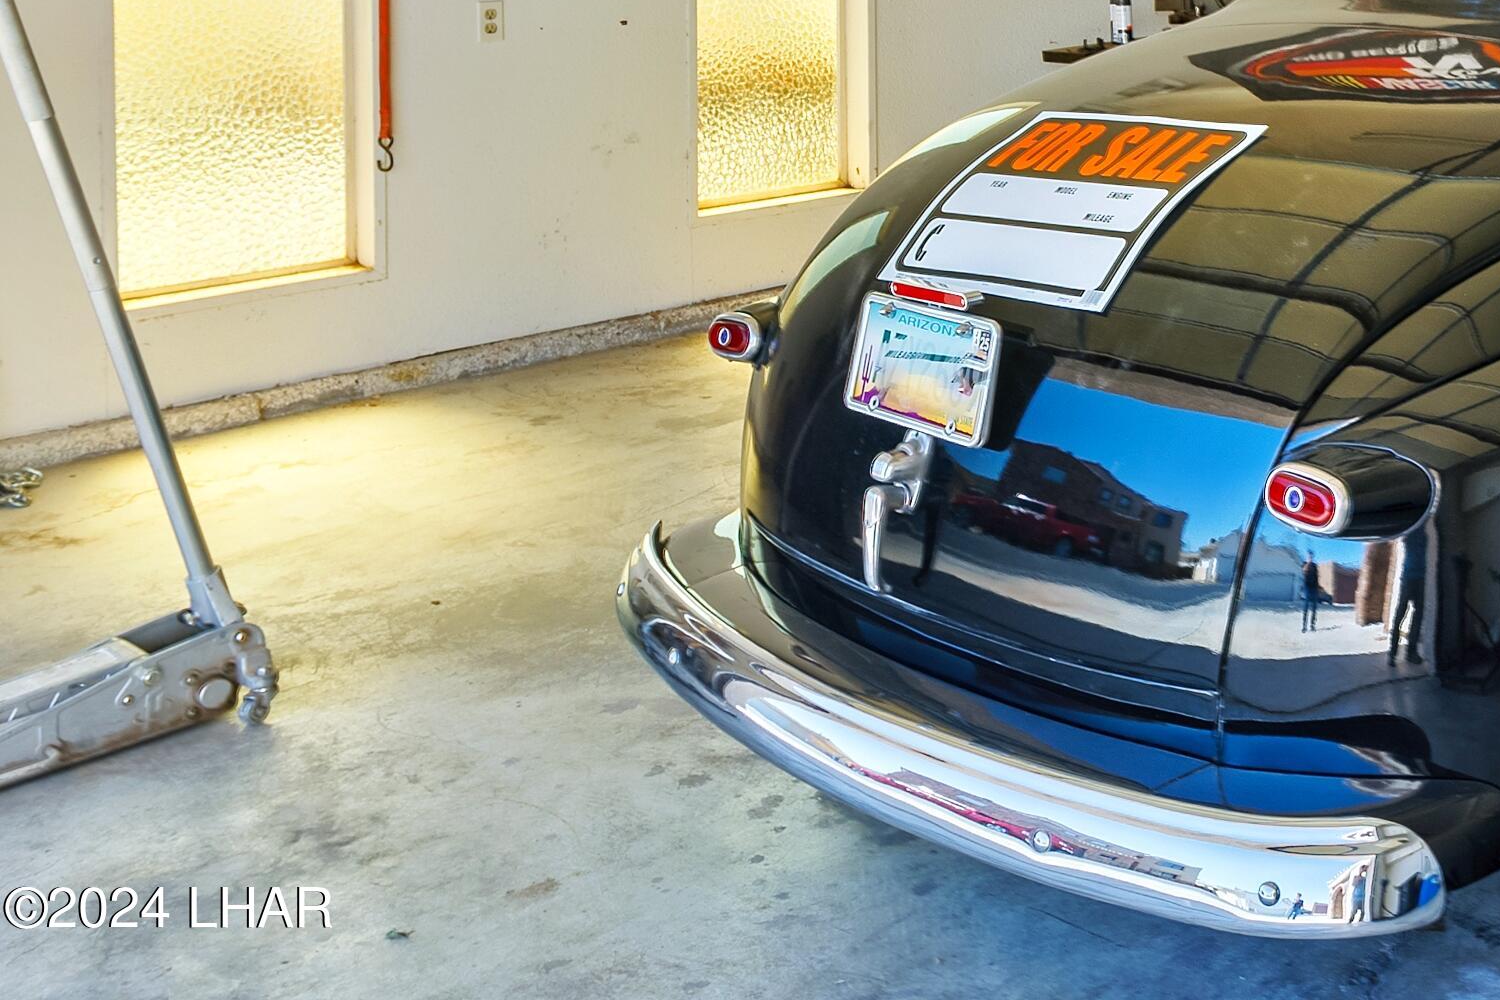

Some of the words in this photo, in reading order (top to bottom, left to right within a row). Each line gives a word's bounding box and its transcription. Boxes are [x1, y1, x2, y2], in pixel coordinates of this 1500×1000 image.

[986, 120, 1107, 173] FOR
[1078, 125, 1233, 184] SALE
[990, 180, 1008, 188] YEAR
[1053, 186, 1078, 195] MODEL
[1106, 191, 1134, 201] ENGINE
[1081, 212, 1115, 223] MILEAGE
